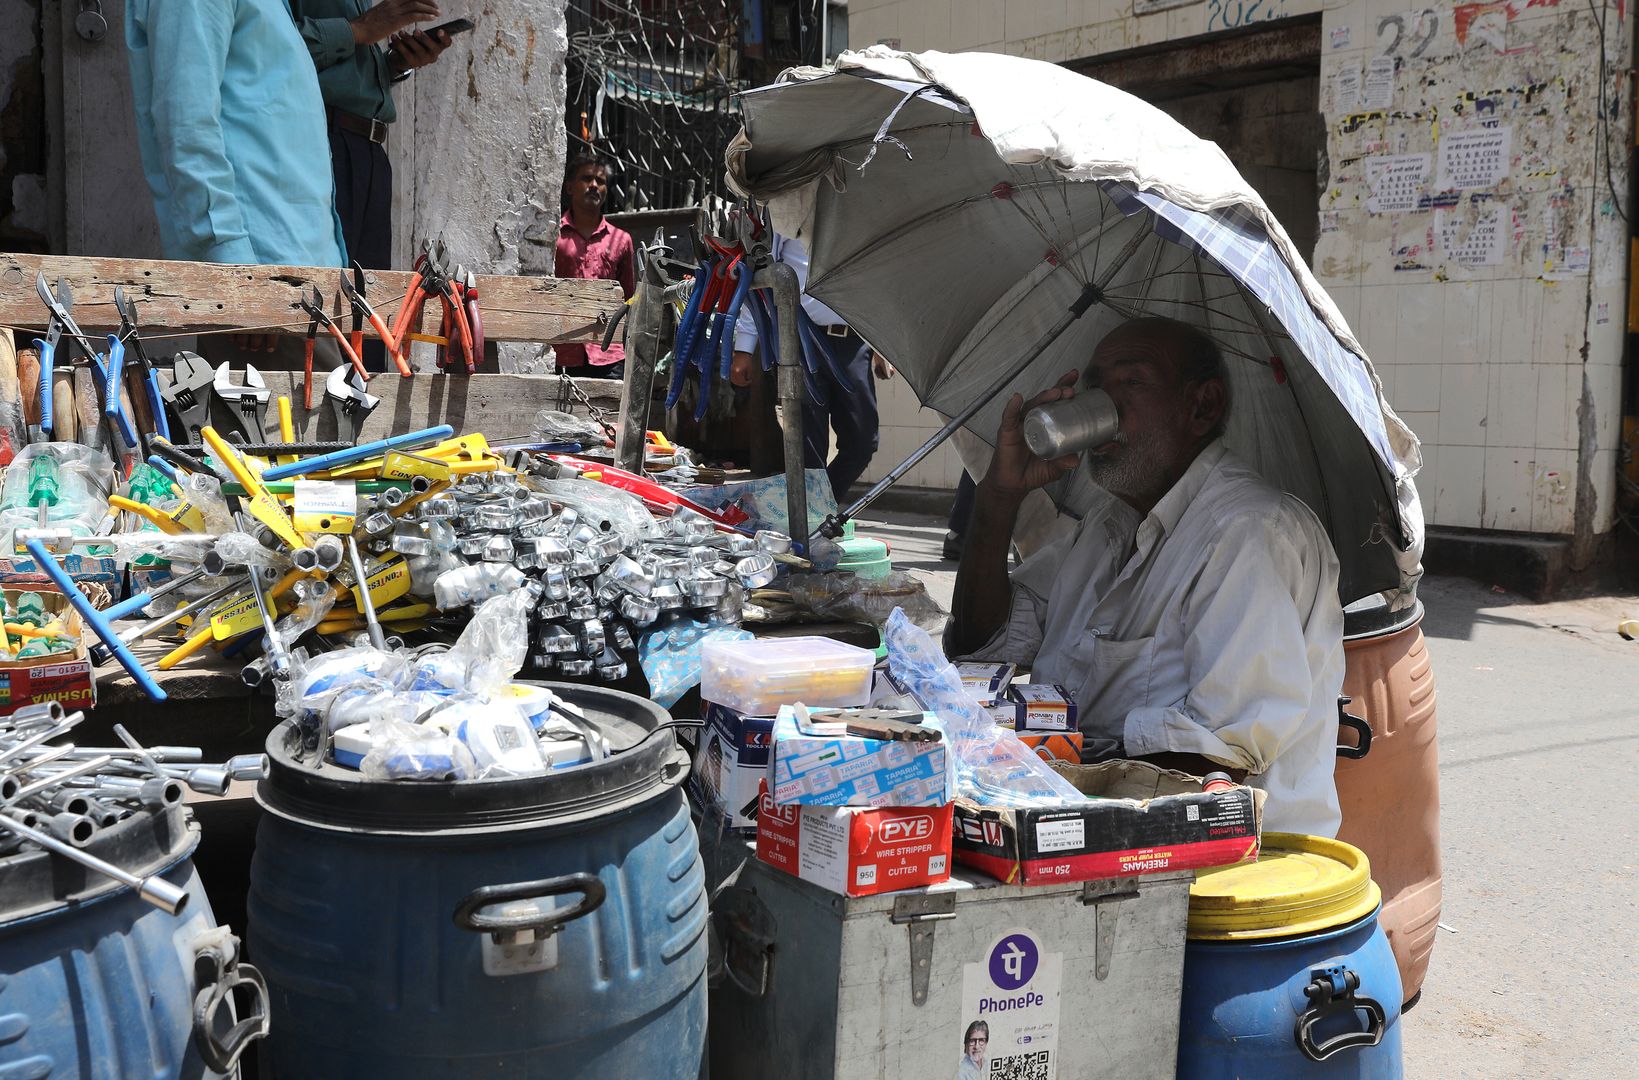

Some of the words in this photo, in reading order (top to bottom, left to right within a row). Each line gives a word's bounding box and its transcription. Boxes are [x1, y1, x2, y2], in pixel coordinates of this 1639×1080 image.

[216, 601, 258, 624] ONTESSA
[1028, 712, 1054, 720] ROMAN
[1056, 715, 1065, 724] 62
[885, 764, 919, 780] TAPARIA
[764, 797, 793, 821] PYE
[884, 819, 928, 839] PYE
[773, 833, 796, 848] STRIPPER
[876, 848, 895, 859] WIRE
[896, 843, 932, 856] STRIPPER
[1139, 853, 1153, 861] PUMP
[1154, 852, 1172, 860] WATER
[768, 851, 787, 864] CUTTER
[900, 857, 906, 865] &
[1119, 855, 1138, 863] PLIERS
[888, 865, 918, 877] CUTTER
[930, 861, 938, 869] 10
[1039, 866, 1054, 874] mm
[1055, 864, 1070, 875] 250
[1123, 859, 1169, 871] FREEMANS
[859, 870, 874, 880] 950
[1001, 941, 1026, 981] पे
[979, 992, 1044, 1014] PhonePe
